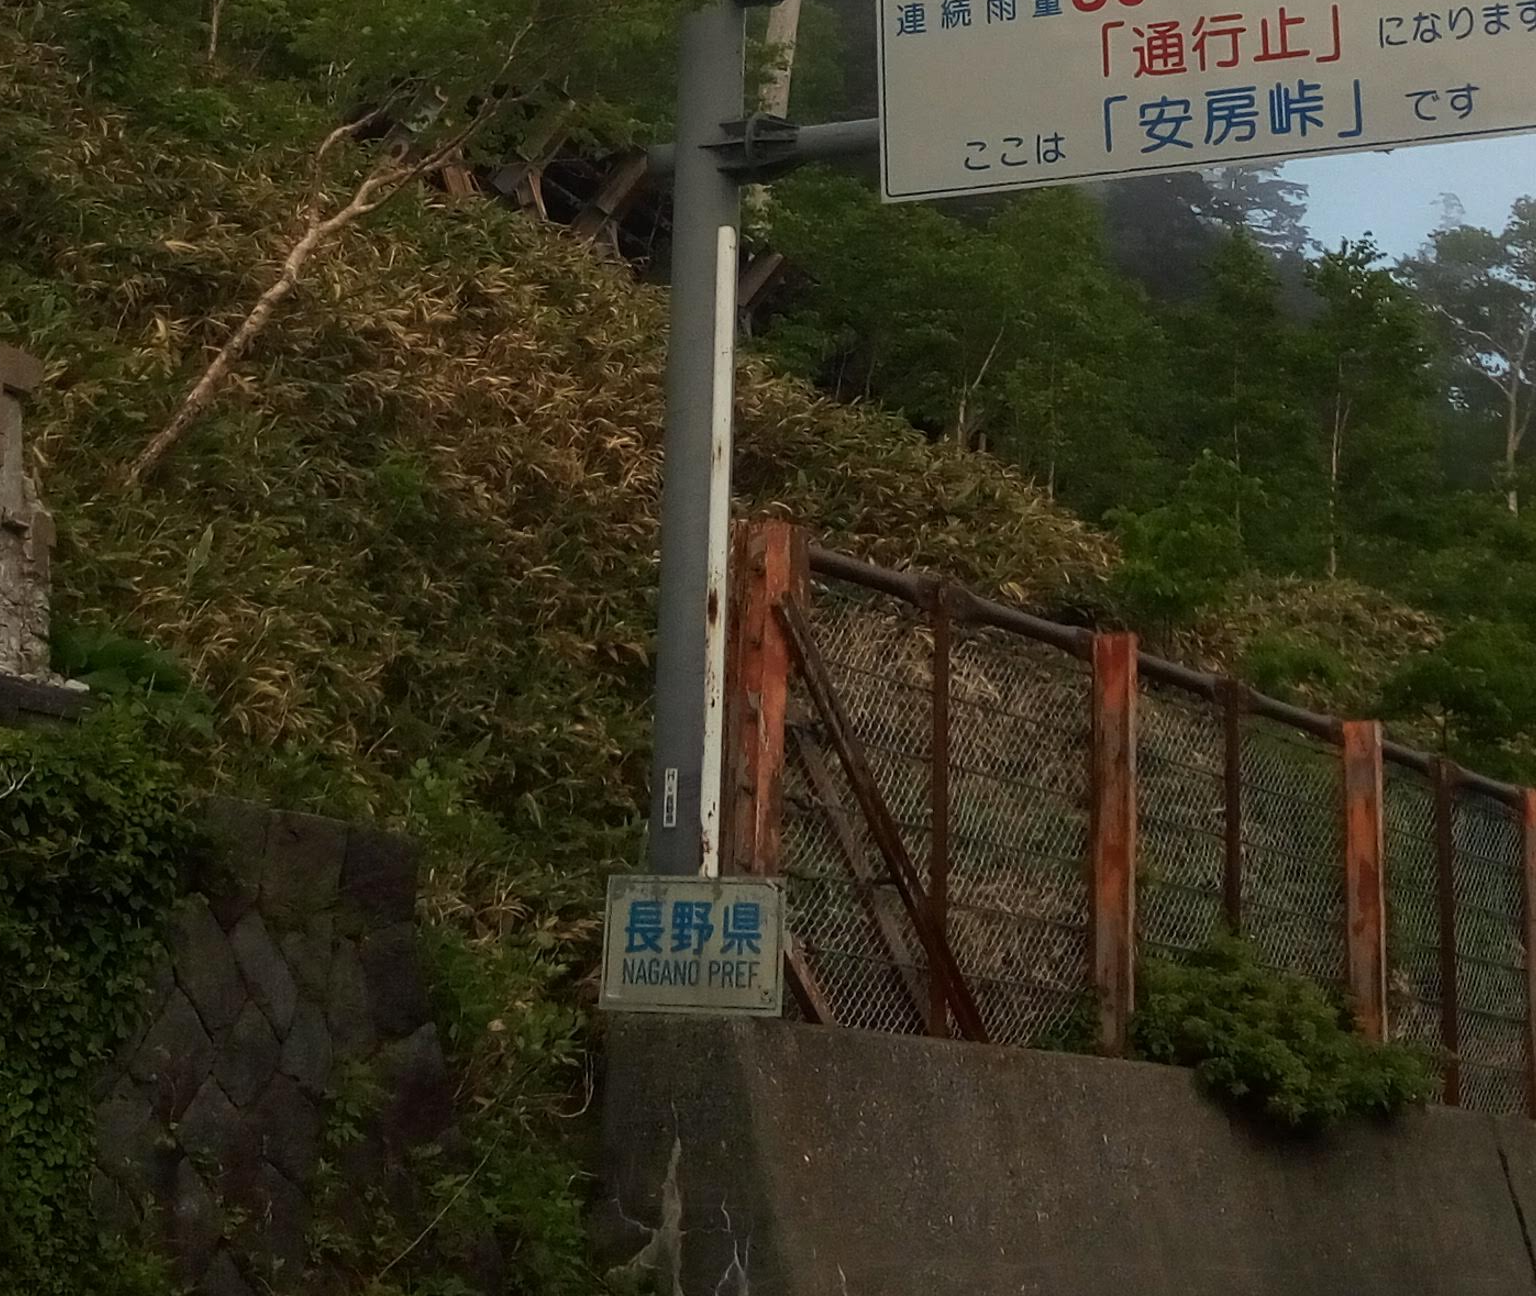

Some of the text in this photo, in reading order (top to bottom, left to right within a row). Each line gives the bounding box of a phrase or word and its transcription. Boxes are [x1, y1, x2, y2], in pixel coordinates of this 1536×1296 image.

[624, 900, 762, 955] 長野県
[622, 958, 762, 989] NAGANO PREF.
